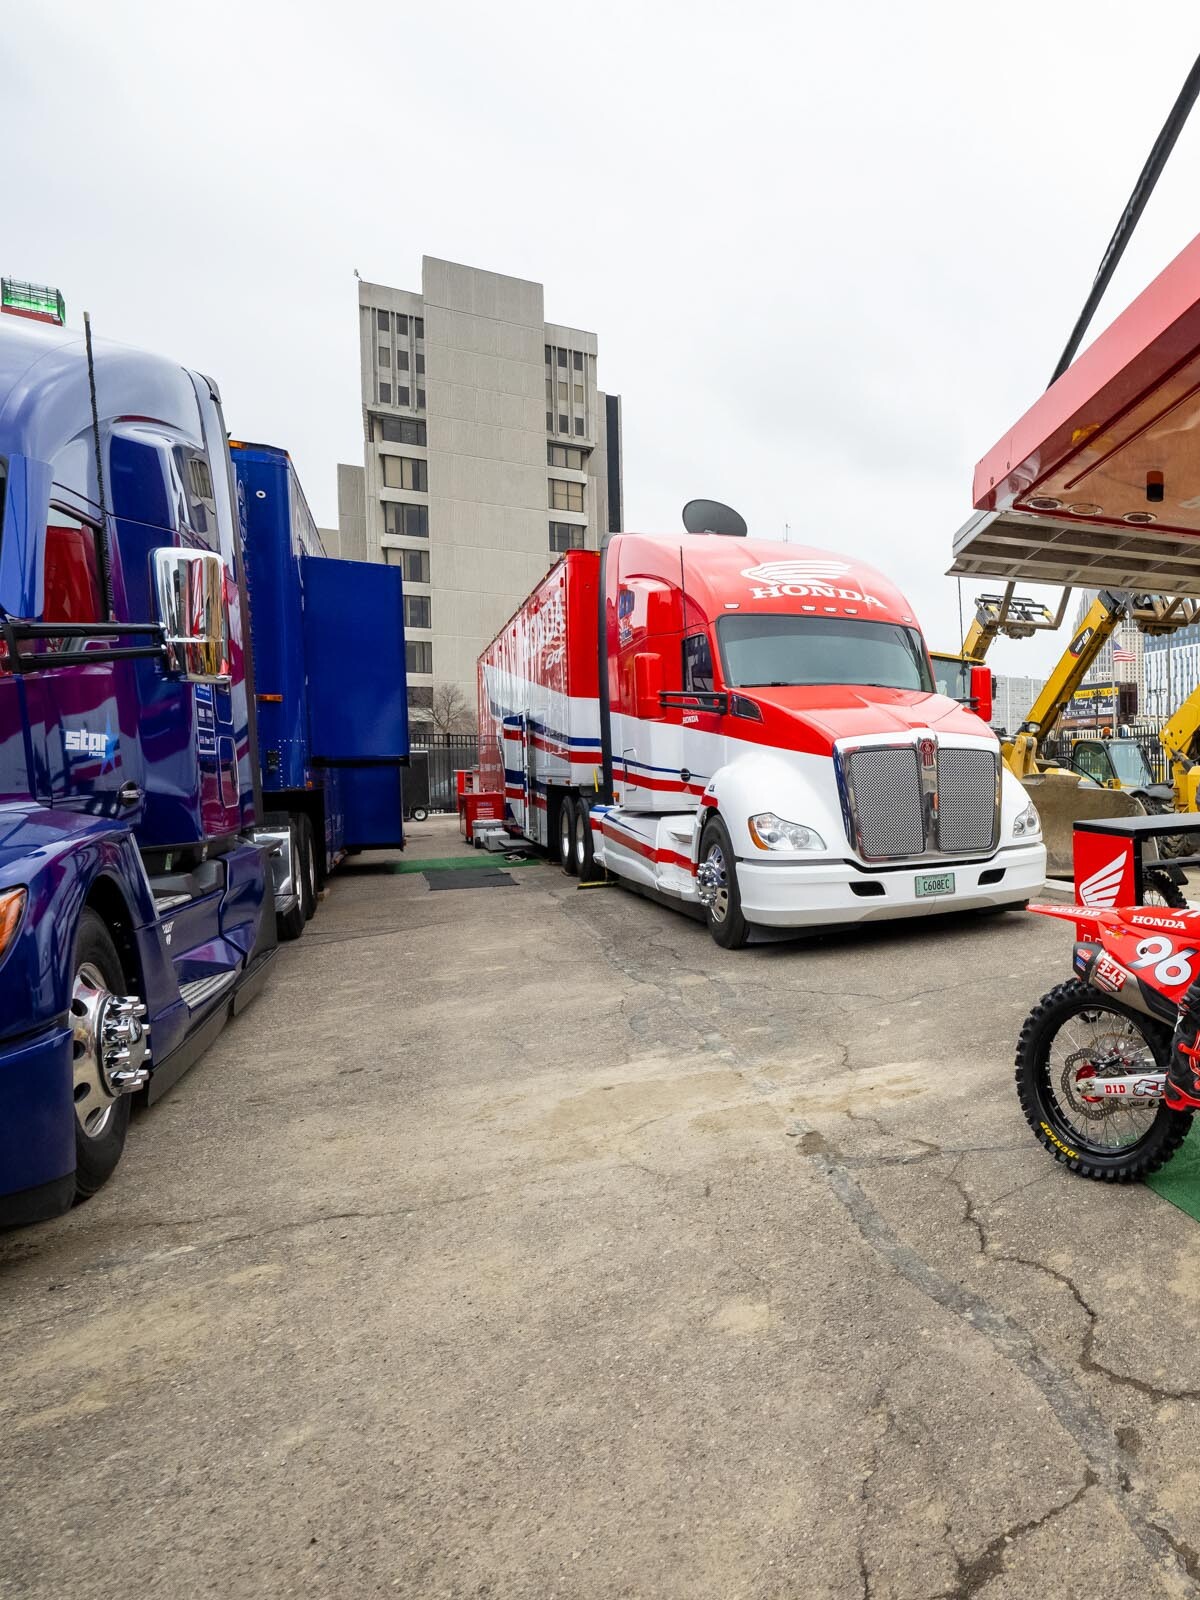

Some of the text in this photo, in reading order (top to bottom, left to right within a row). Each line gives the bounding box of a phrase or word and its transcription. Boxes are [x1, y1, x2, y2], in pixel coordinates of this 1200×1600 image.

[748, 583, 888, 610] HONDA
[65, 729, 109, 751] star
[923, 878, 950, 892] C608EC
[1050, 906, 1102, 917] DUNLOP
[1131, 915, 1187, 930] HONDA
[1127, 935, 1192, 987] 96
[1040, 1121, 1077, 1158] DUNLOP
